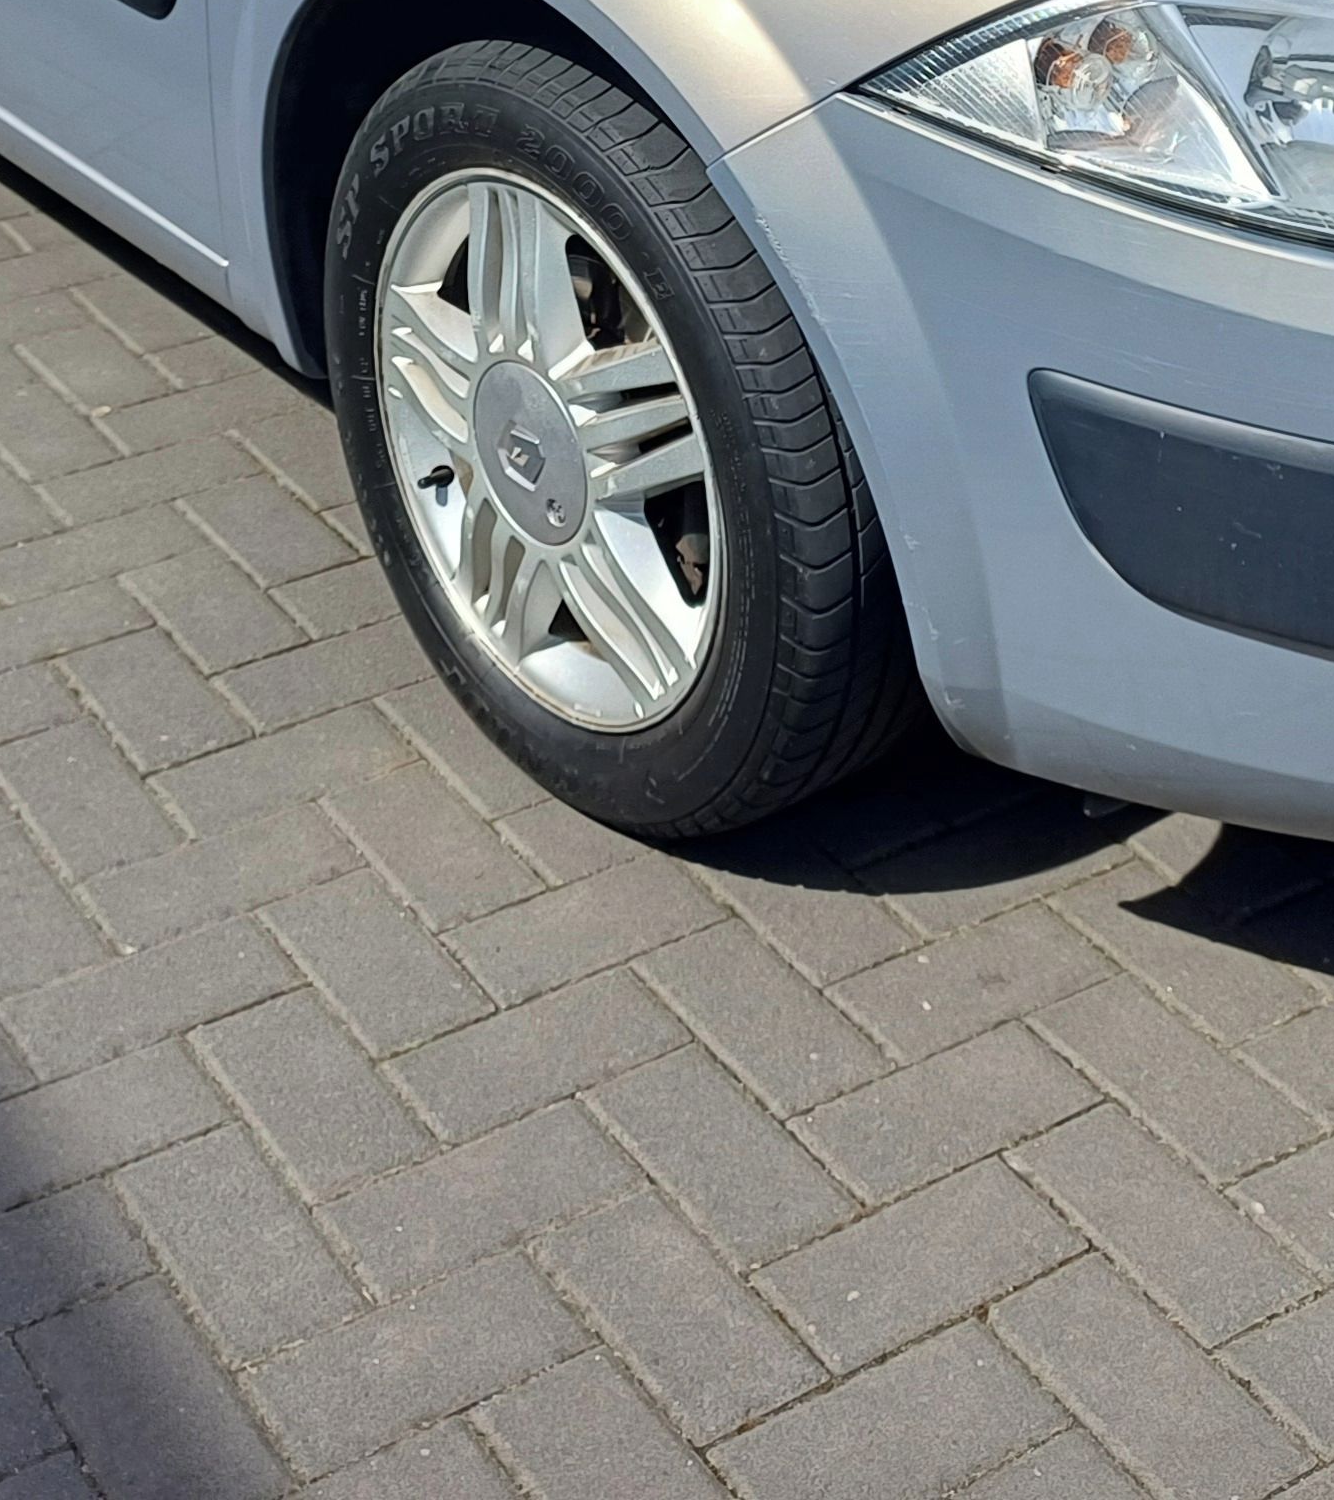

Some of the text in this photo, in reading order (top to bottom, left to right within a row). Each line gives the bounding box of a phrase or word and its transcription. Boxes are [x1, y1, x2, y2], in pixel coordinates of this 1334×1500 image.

[336, 172, 361, 261] SP
[369, 102, 501, 179] SPORT
[518, 122, 635, 244] 2000
